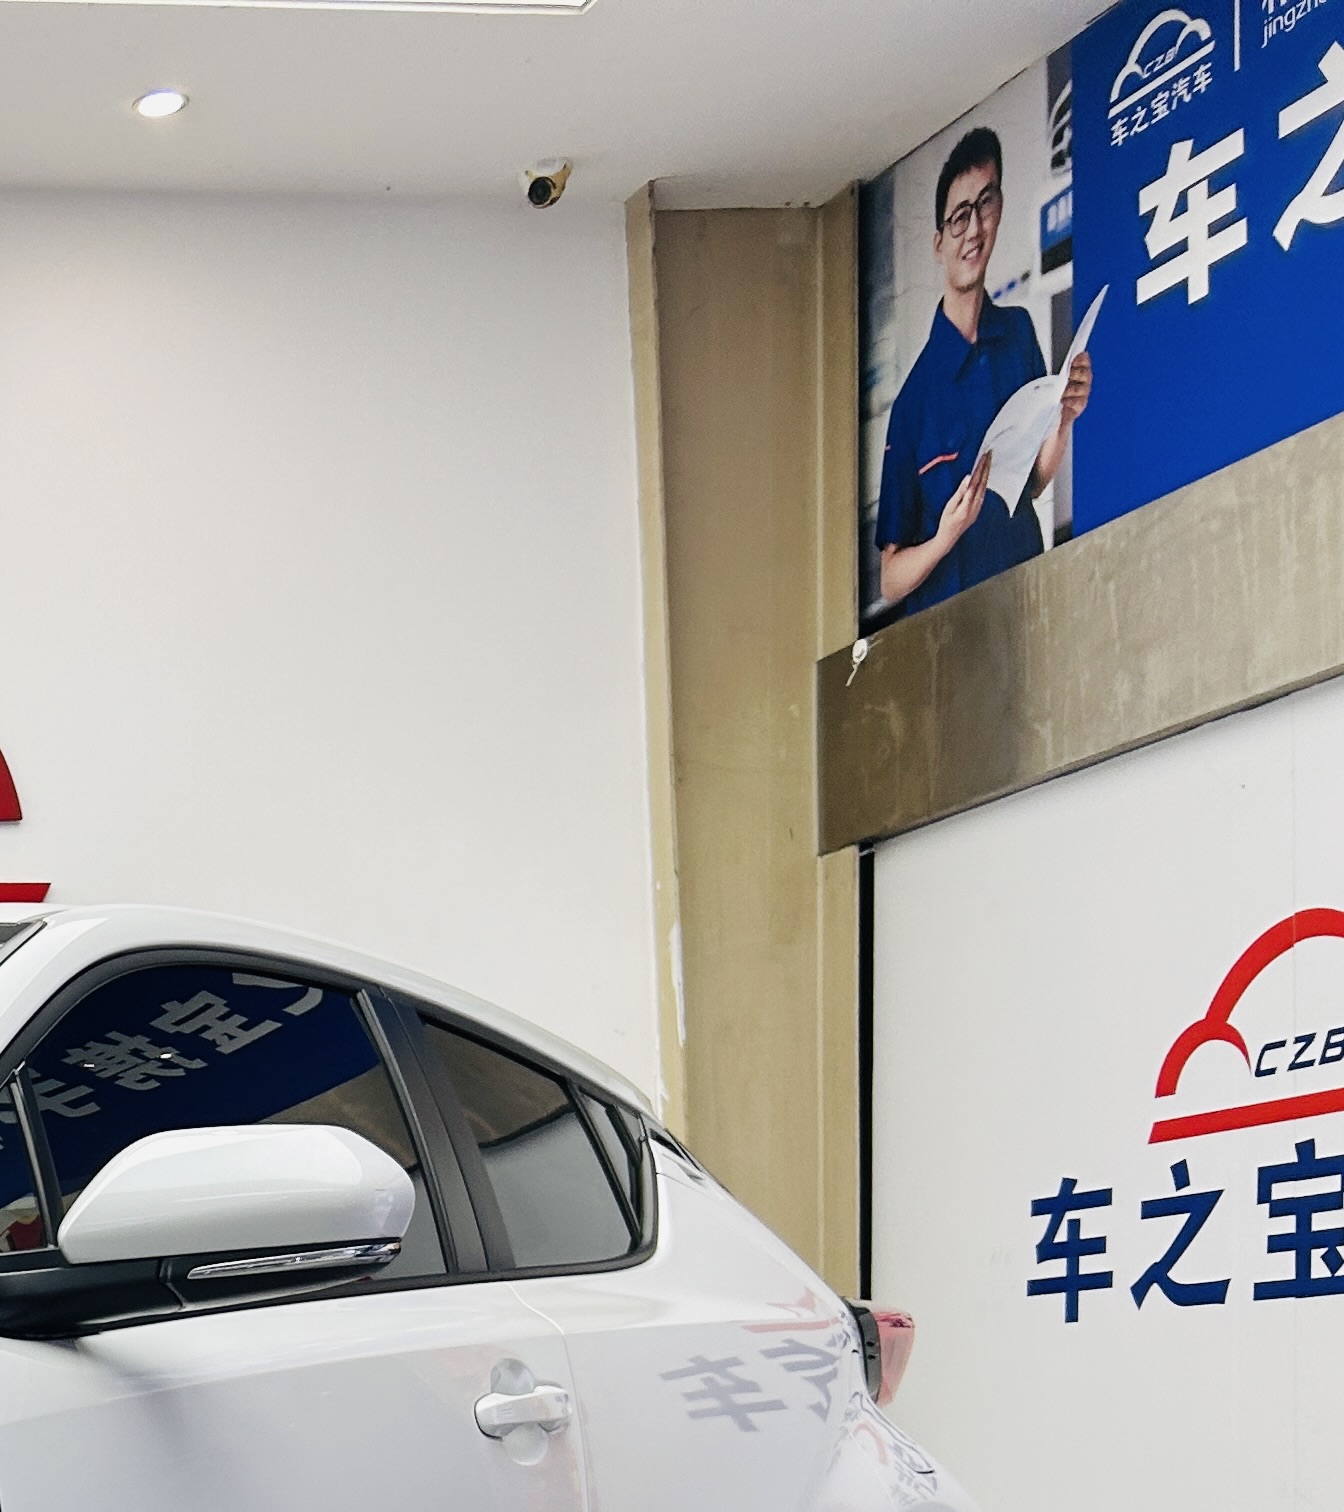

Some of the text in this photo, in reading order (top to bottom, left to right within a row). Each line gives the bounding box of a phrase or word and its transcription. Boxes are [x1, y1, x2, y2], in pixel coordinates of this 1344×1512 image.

[1110, 62, 1213, 147] 车之宝汽车
[1026, 1139, 1344, 1324] 车之宝
